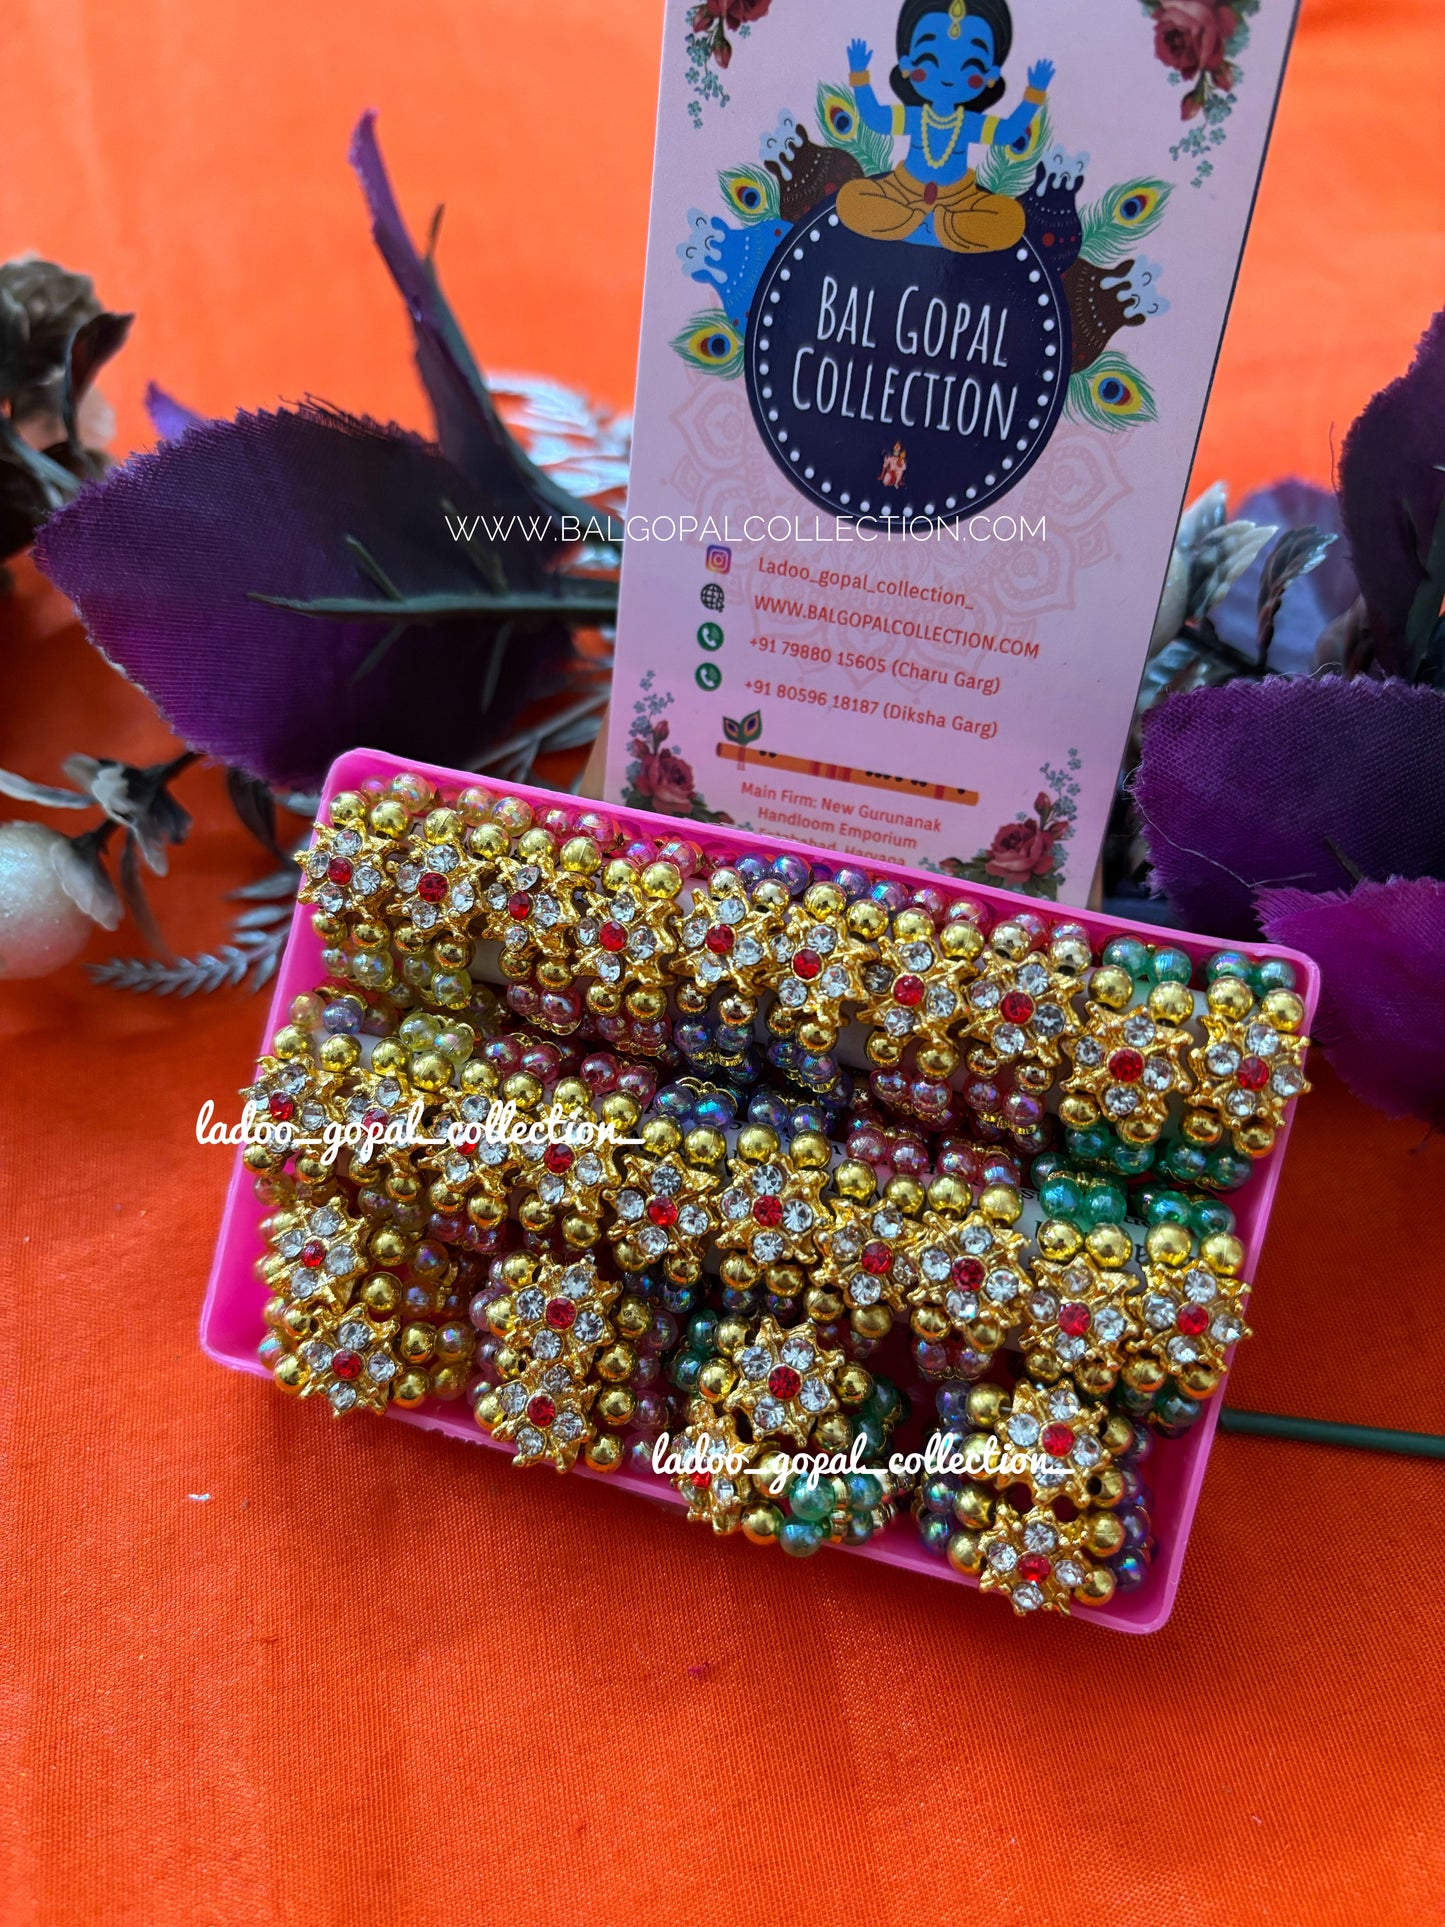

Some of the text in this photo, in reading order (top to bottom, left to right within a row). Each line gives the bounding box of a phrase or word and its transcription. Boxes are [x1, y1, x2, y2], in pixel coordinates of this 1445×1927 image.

[815, 275, 1009, 369] BAL GOPAL
[791, 346, 1018, 441] COLLECTION
[758, 556, 974, 611] Ladoo_gopal_collection_
[754, 594, 1040, 660] WWW.BALGOPALCOLLECTION.COM
[749, 636, 1001, 697] +91 79880 15605 (Charu Garg)
[744, 679, 998, 740] +91 80596 18187 (Diksha Garg)
[740, 781, 943, 833] Main Firm: New Gurunanak
[757, 806, 918, 850] Handloom Emporium
